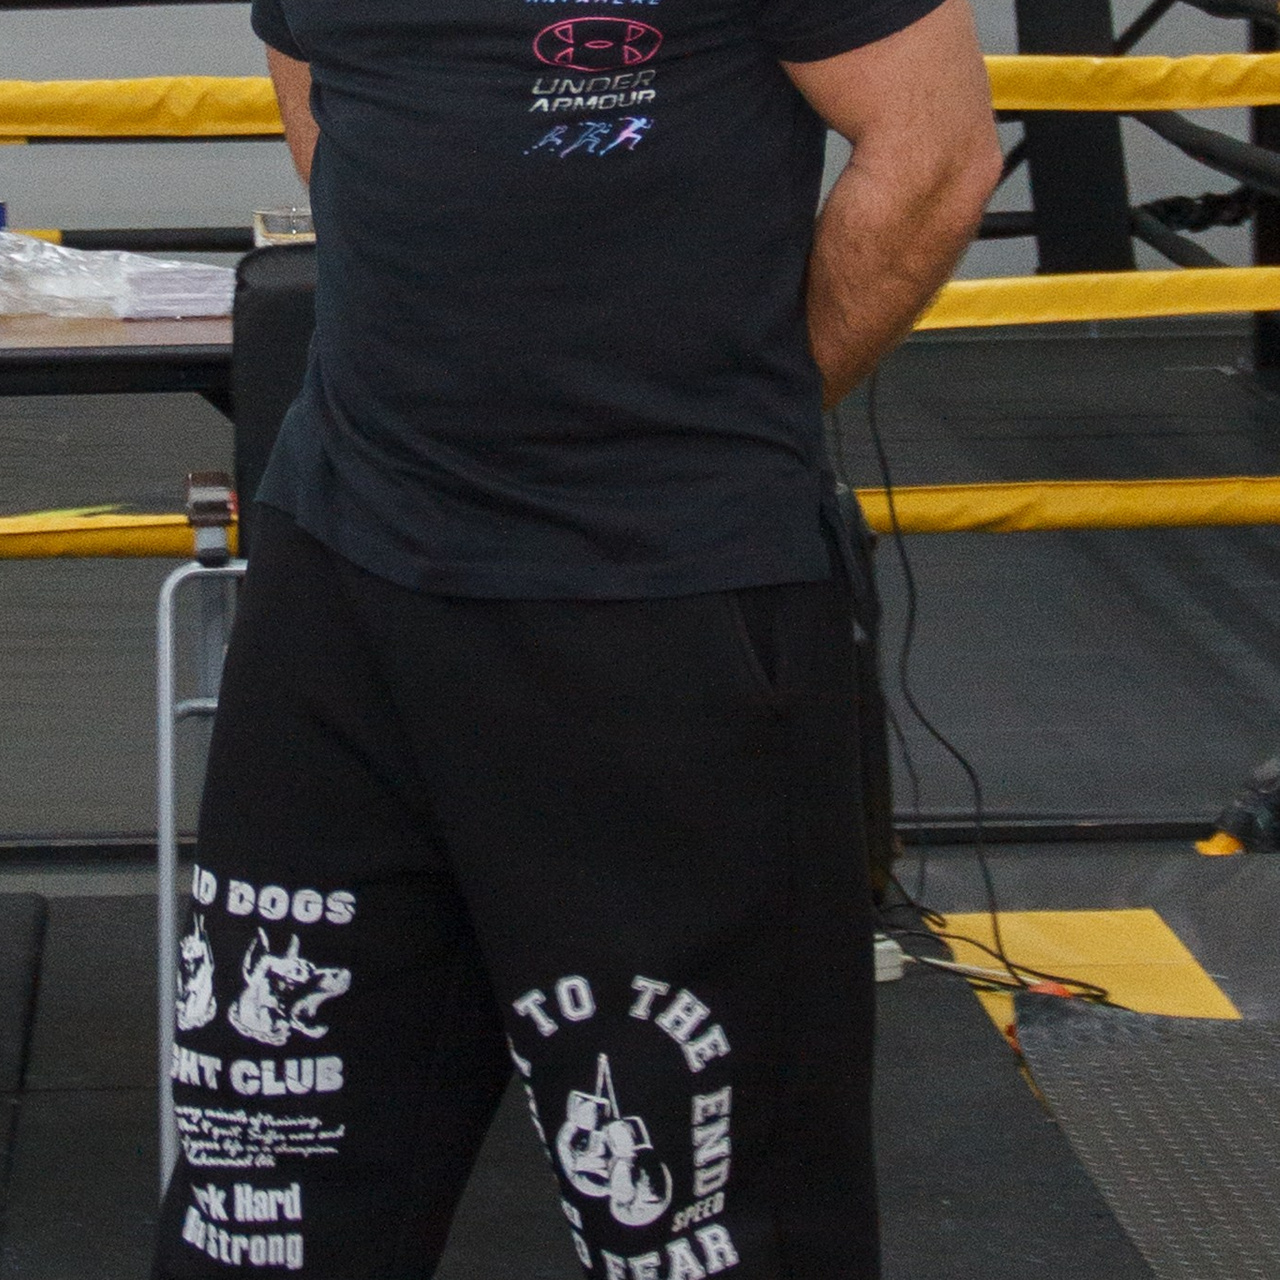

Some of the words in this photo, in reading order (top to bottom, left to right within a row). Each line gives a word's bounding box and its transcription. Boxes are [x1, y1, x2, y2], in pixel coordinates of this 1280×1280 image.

[528, 89, 657, 113] ARMOUR
[531, 69, 657, 95] UNDER
[226, 878, 357, 925] DOGS
[513, 975, 596, 1037] TO
[628, 975, 732, 1074] THE
[230, 1055, 345, 1097] CLUB
[691, 1086, 733, 1198] END
[233, 1182, 302, 1222] Hard
